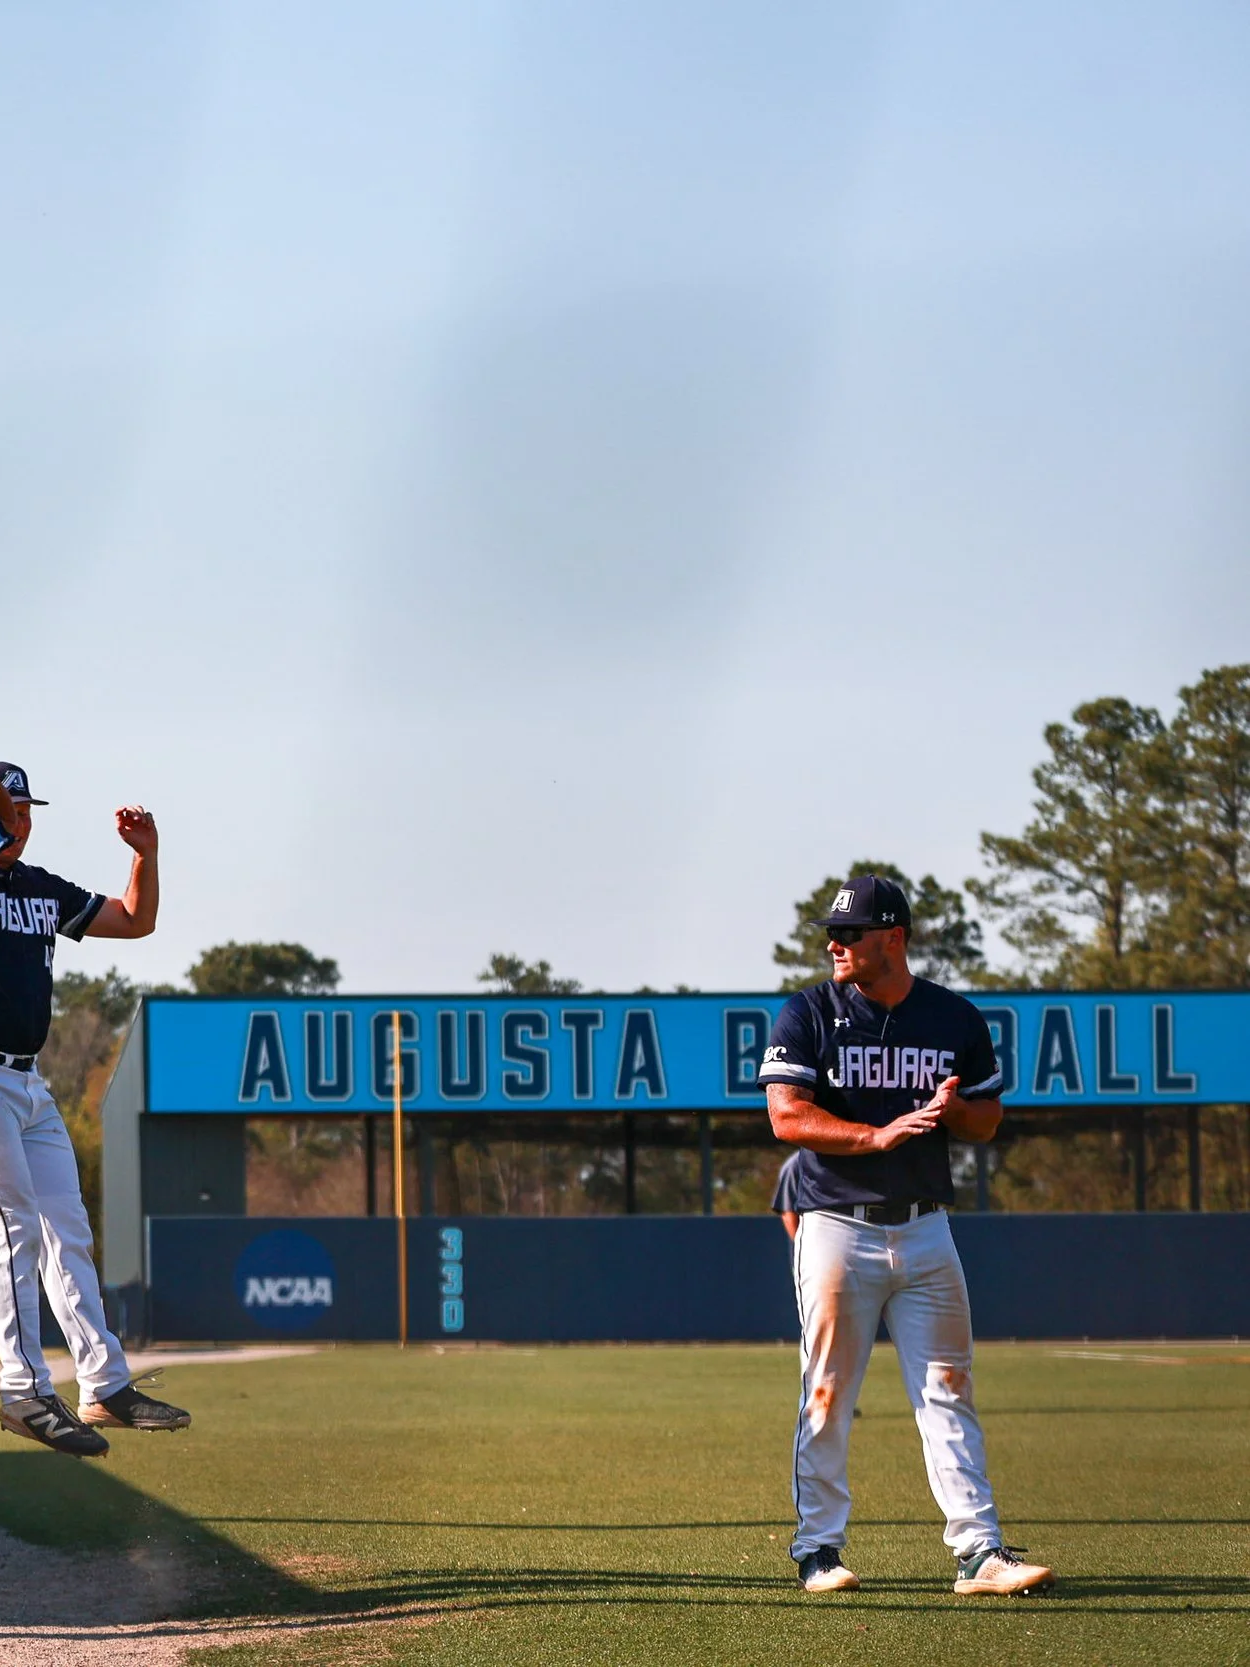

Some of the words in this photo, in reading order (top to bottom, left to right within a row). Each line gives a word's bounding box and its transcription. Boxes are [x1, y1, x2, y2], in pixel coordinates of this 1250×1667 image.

[238, 1010, 668, 1101] AUGUSTA
[245, 1277, 333, 1306] NCAA
[440, 1227, 465, 1332] 330
